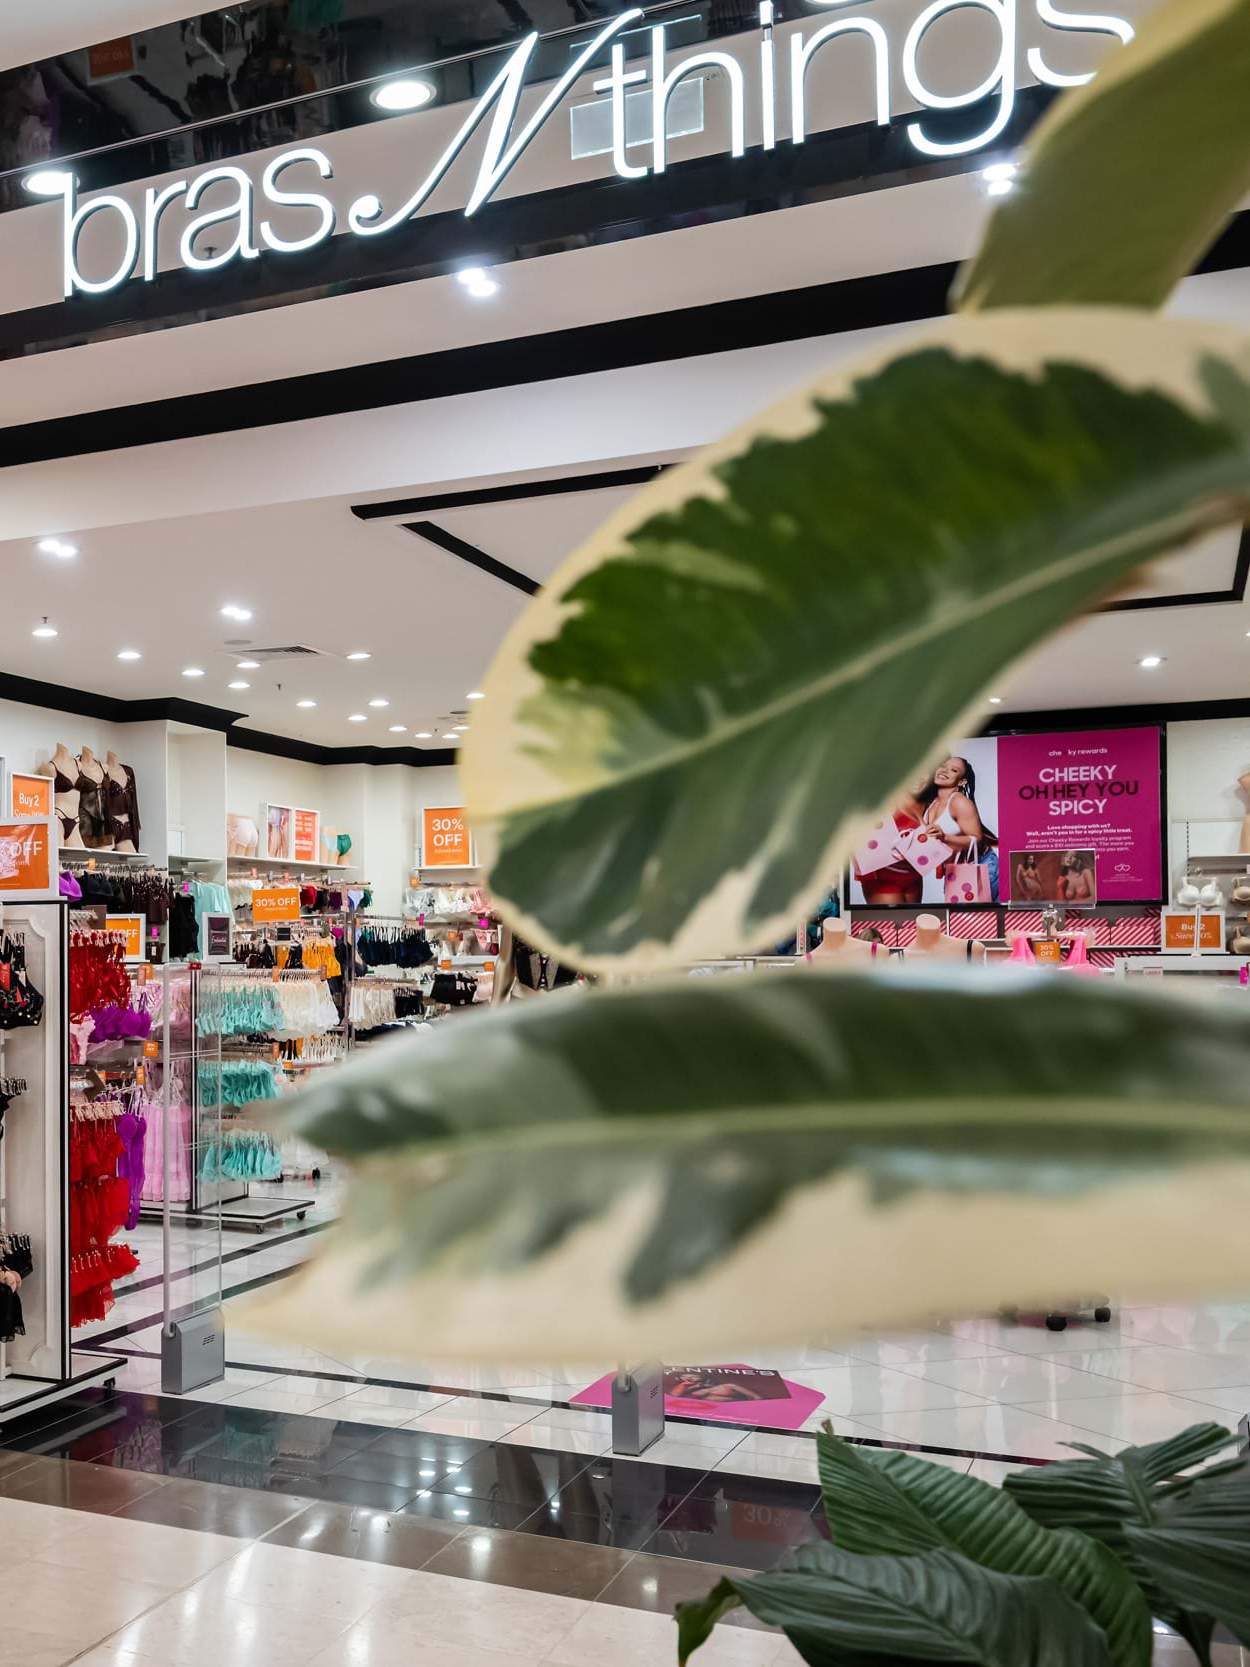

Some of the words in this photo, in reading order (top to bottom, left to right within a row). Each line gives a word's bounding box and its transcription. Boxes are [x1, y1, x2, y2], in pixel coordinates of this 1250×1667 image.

[63, 147, 337, 298] bras
[348, 6, 645, 238] N
[593, 0, 1136, 179] things
[1077, 747, 1108, 756] rewards
[1038, 764, 1118, 783] CHEEKY
[1018, 785, 1049, 800] OH
[1053, 783, 1090, 799] HEY
[1095, 780, 1139, 797] YOU
[19, 792, 33, 808] Buy
[34, 794, 39, 807] 2
[1048, 798, 1108, 816] SPICY
[431, 817, 464, 832] 30%
[433, 833, 463, 847] OFF
[10, 840, 43, 857] OFF
[255, 897, 276, 908] 30%
[277, 896, 297, 906] OFF
